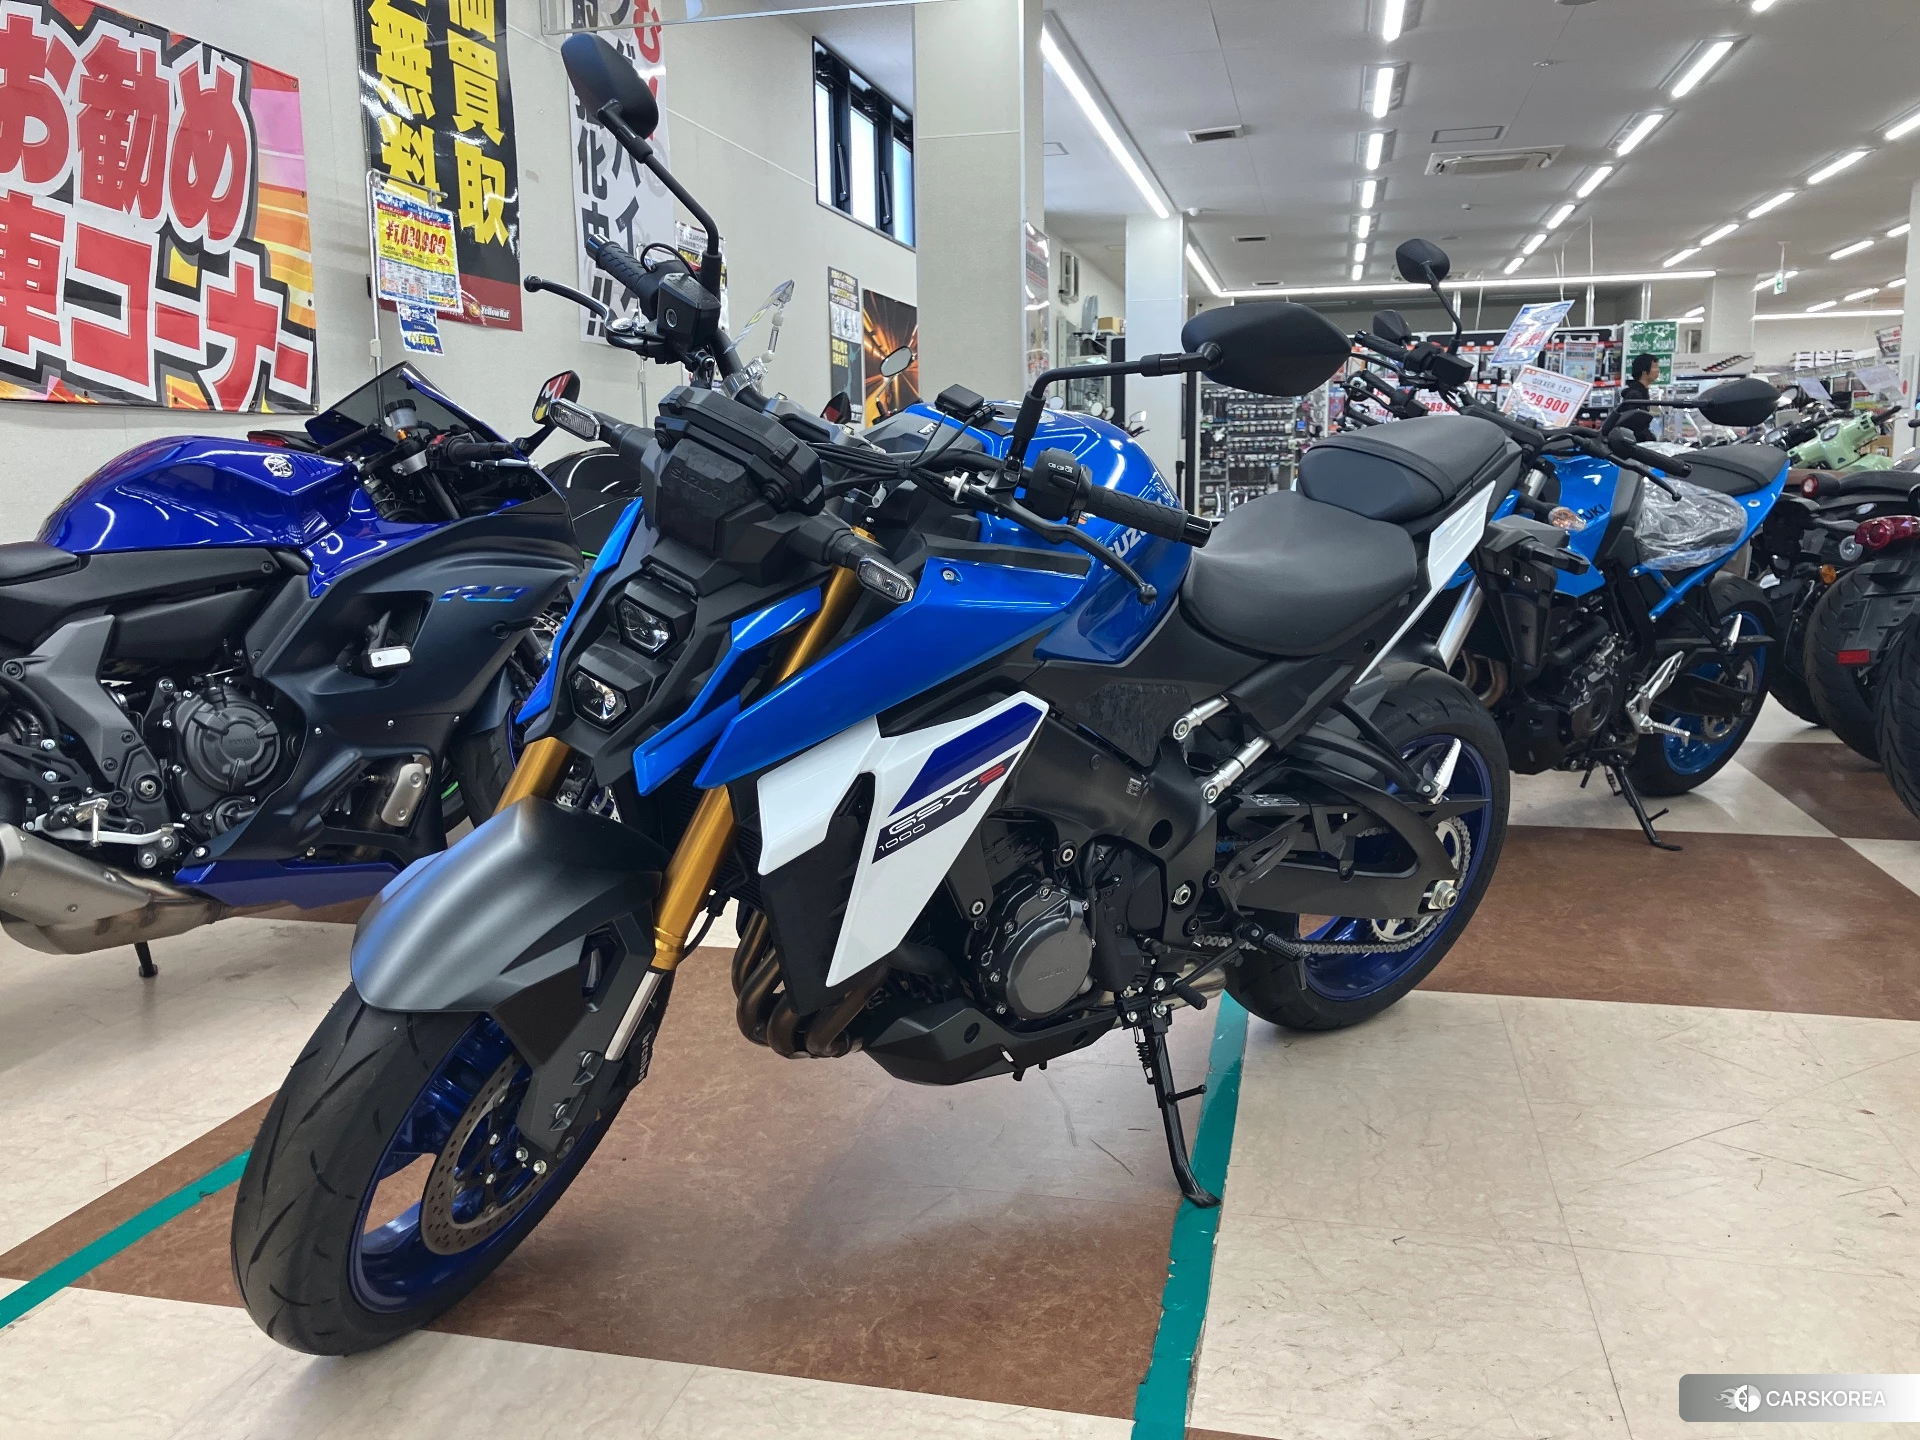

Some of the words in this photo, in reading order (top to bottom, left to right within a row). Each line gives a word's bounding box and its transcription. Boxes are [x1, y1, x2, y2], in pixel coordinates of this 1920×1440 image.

[0, 16, 247, 240] お勧め
[367, 0, 442, 205] 無料
[0, 191, 309, 411] 車コーナー
[1580, 504, 1607, 520] UKI
[889, 762, 1006, 836] GSX-S
[878, 823, 926, 852] 1000
[637, 1030, 652, 1082] brembo
